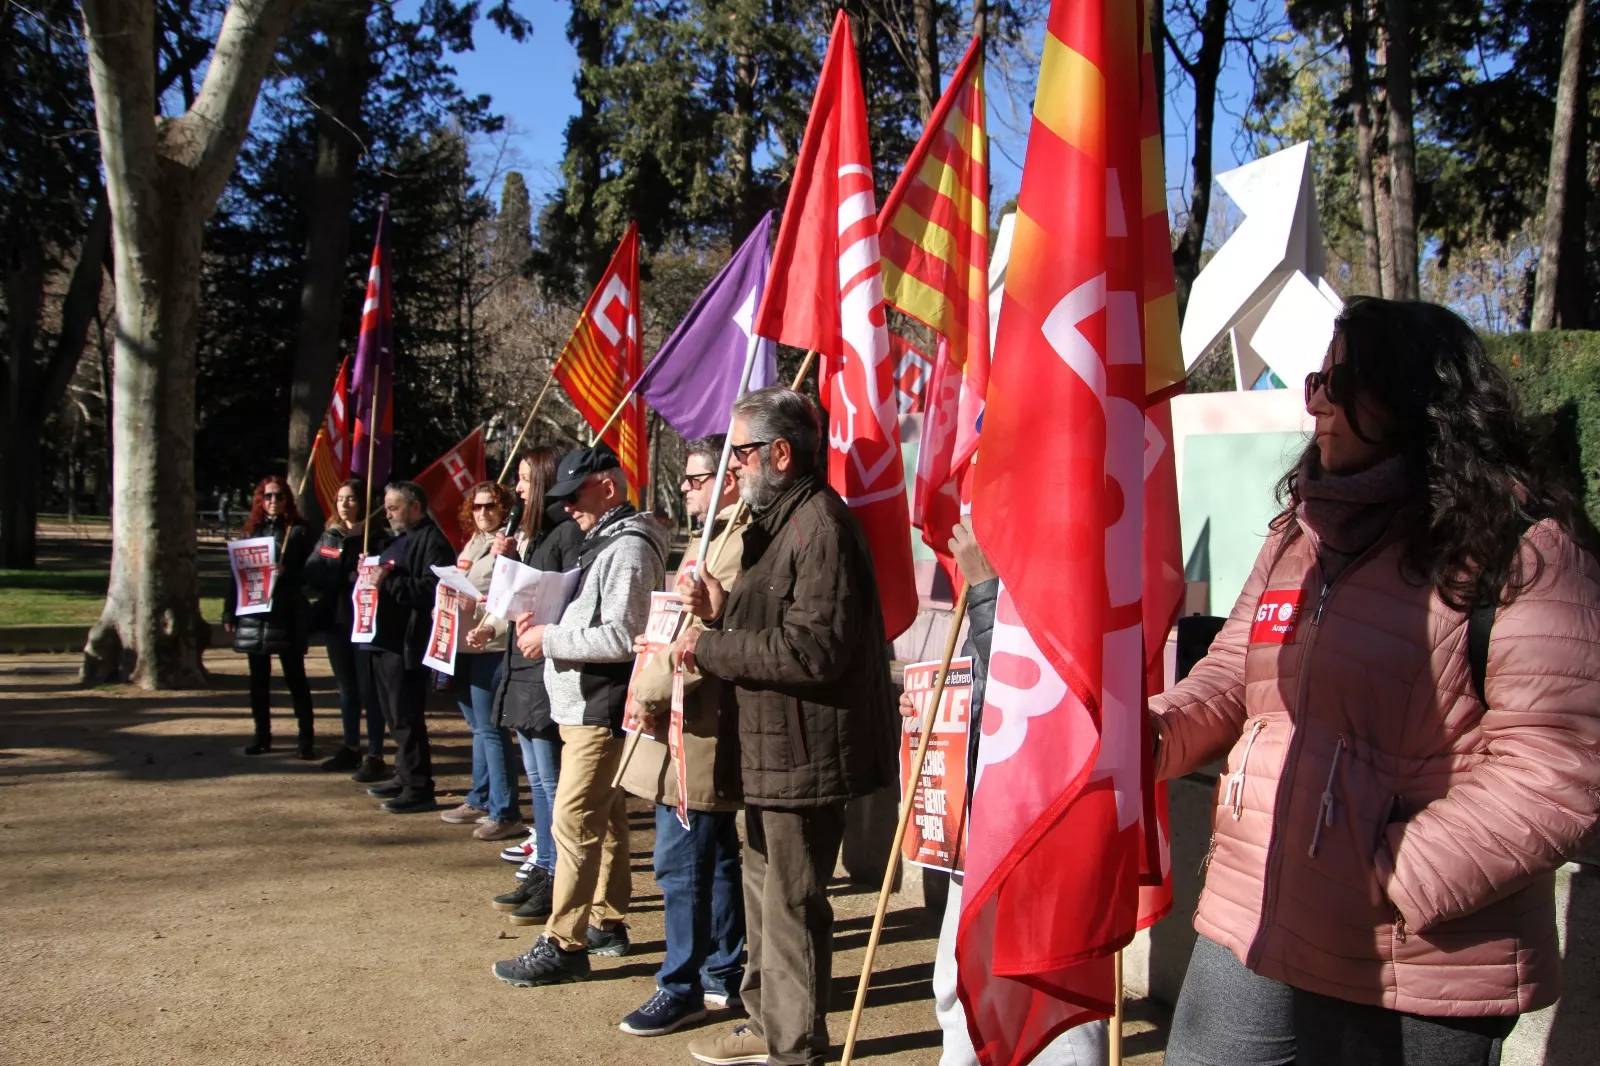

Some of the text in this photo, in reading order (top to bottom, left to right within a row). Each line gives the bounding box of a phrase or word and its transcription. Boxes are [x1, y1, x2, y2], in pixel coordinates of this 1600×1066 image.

[950, 671, 971, 686] febrero
[924, 787, 947, 815] GENTE
[922, 814, 945, 843] JUEGA
